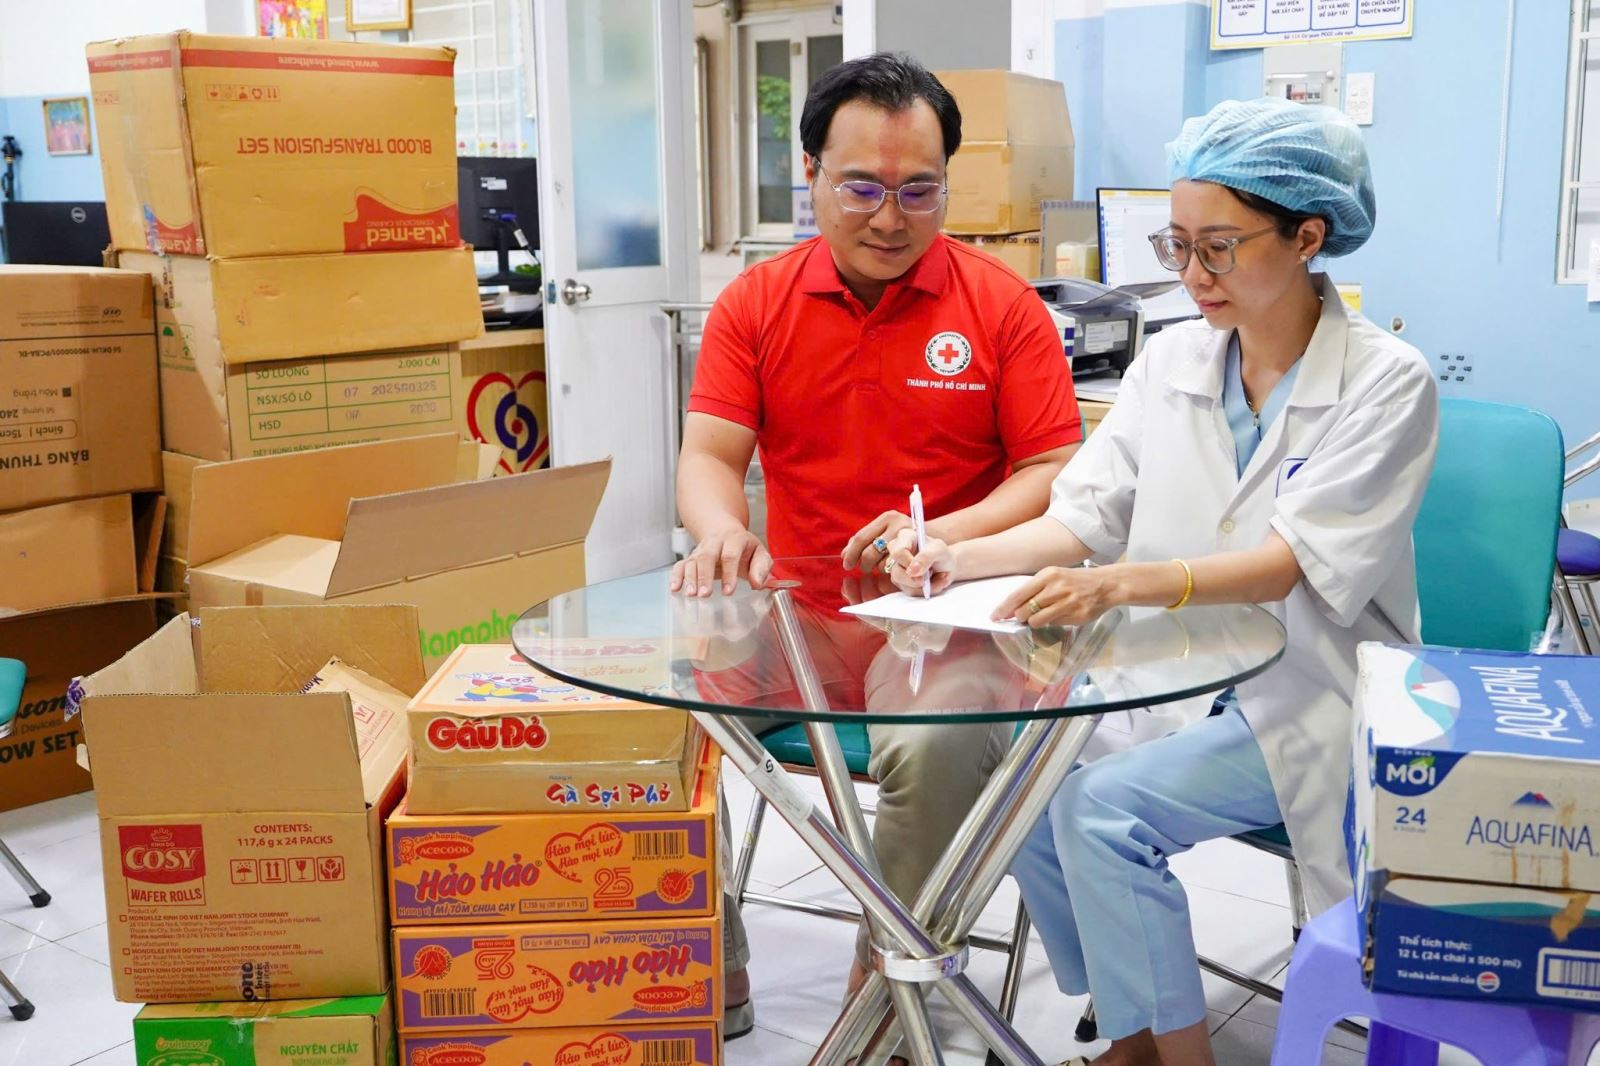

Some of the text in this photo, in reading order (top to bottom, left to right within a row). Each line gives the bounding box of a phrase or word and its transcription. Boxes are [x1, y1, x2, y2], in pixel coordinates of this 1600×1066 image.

[237, 137, 432, 154] BLOOD TRANSFUSION SET
[906, 378, 928, 388] THÀNH
[930, 380, 944, 389] PHỐ
[956, 382, 968, 390] CHÍ
[258, 420, 281, 430] HSD
[1469, 666, 1584, 744] AQUAFINA
[42, 730, 79, 754] SET
[427, 716, 499, 750] Gấu
[499, 715, 548, 750] Đỏ
[546, 782, 672, 808] Gà Sợi Phở
[1396, 806, 1426, 826] 24
[254, 824, 312, 834] CONTENTS:
[1466, 815, 1594, 857] AQUAFINA
[238, 838, 266, 848] 117,6
[268, 839, 274, 848] g
[284, 837, 298, 845] 24
[300, 836, 334, 845] PACKS
[416, 853, 540, 902] Hảo Hảo
[594, 867, 634, 898] 25
[130, 888, 202, 903] WAFER ROLLS
[498, 902, 516, 912] CAY
[594, 935, 611, 944] CAY
[1399, 934, 1472, 951] Thể tích thực:
[474, 950, 516, 980] 25
[1398, 949, 1522, 969] 12 L (24 chai x 500 ml)
[569, 946, 692, 993] Hảo Hảo
[280, 1042, 326, 1056] NGUYÊN
